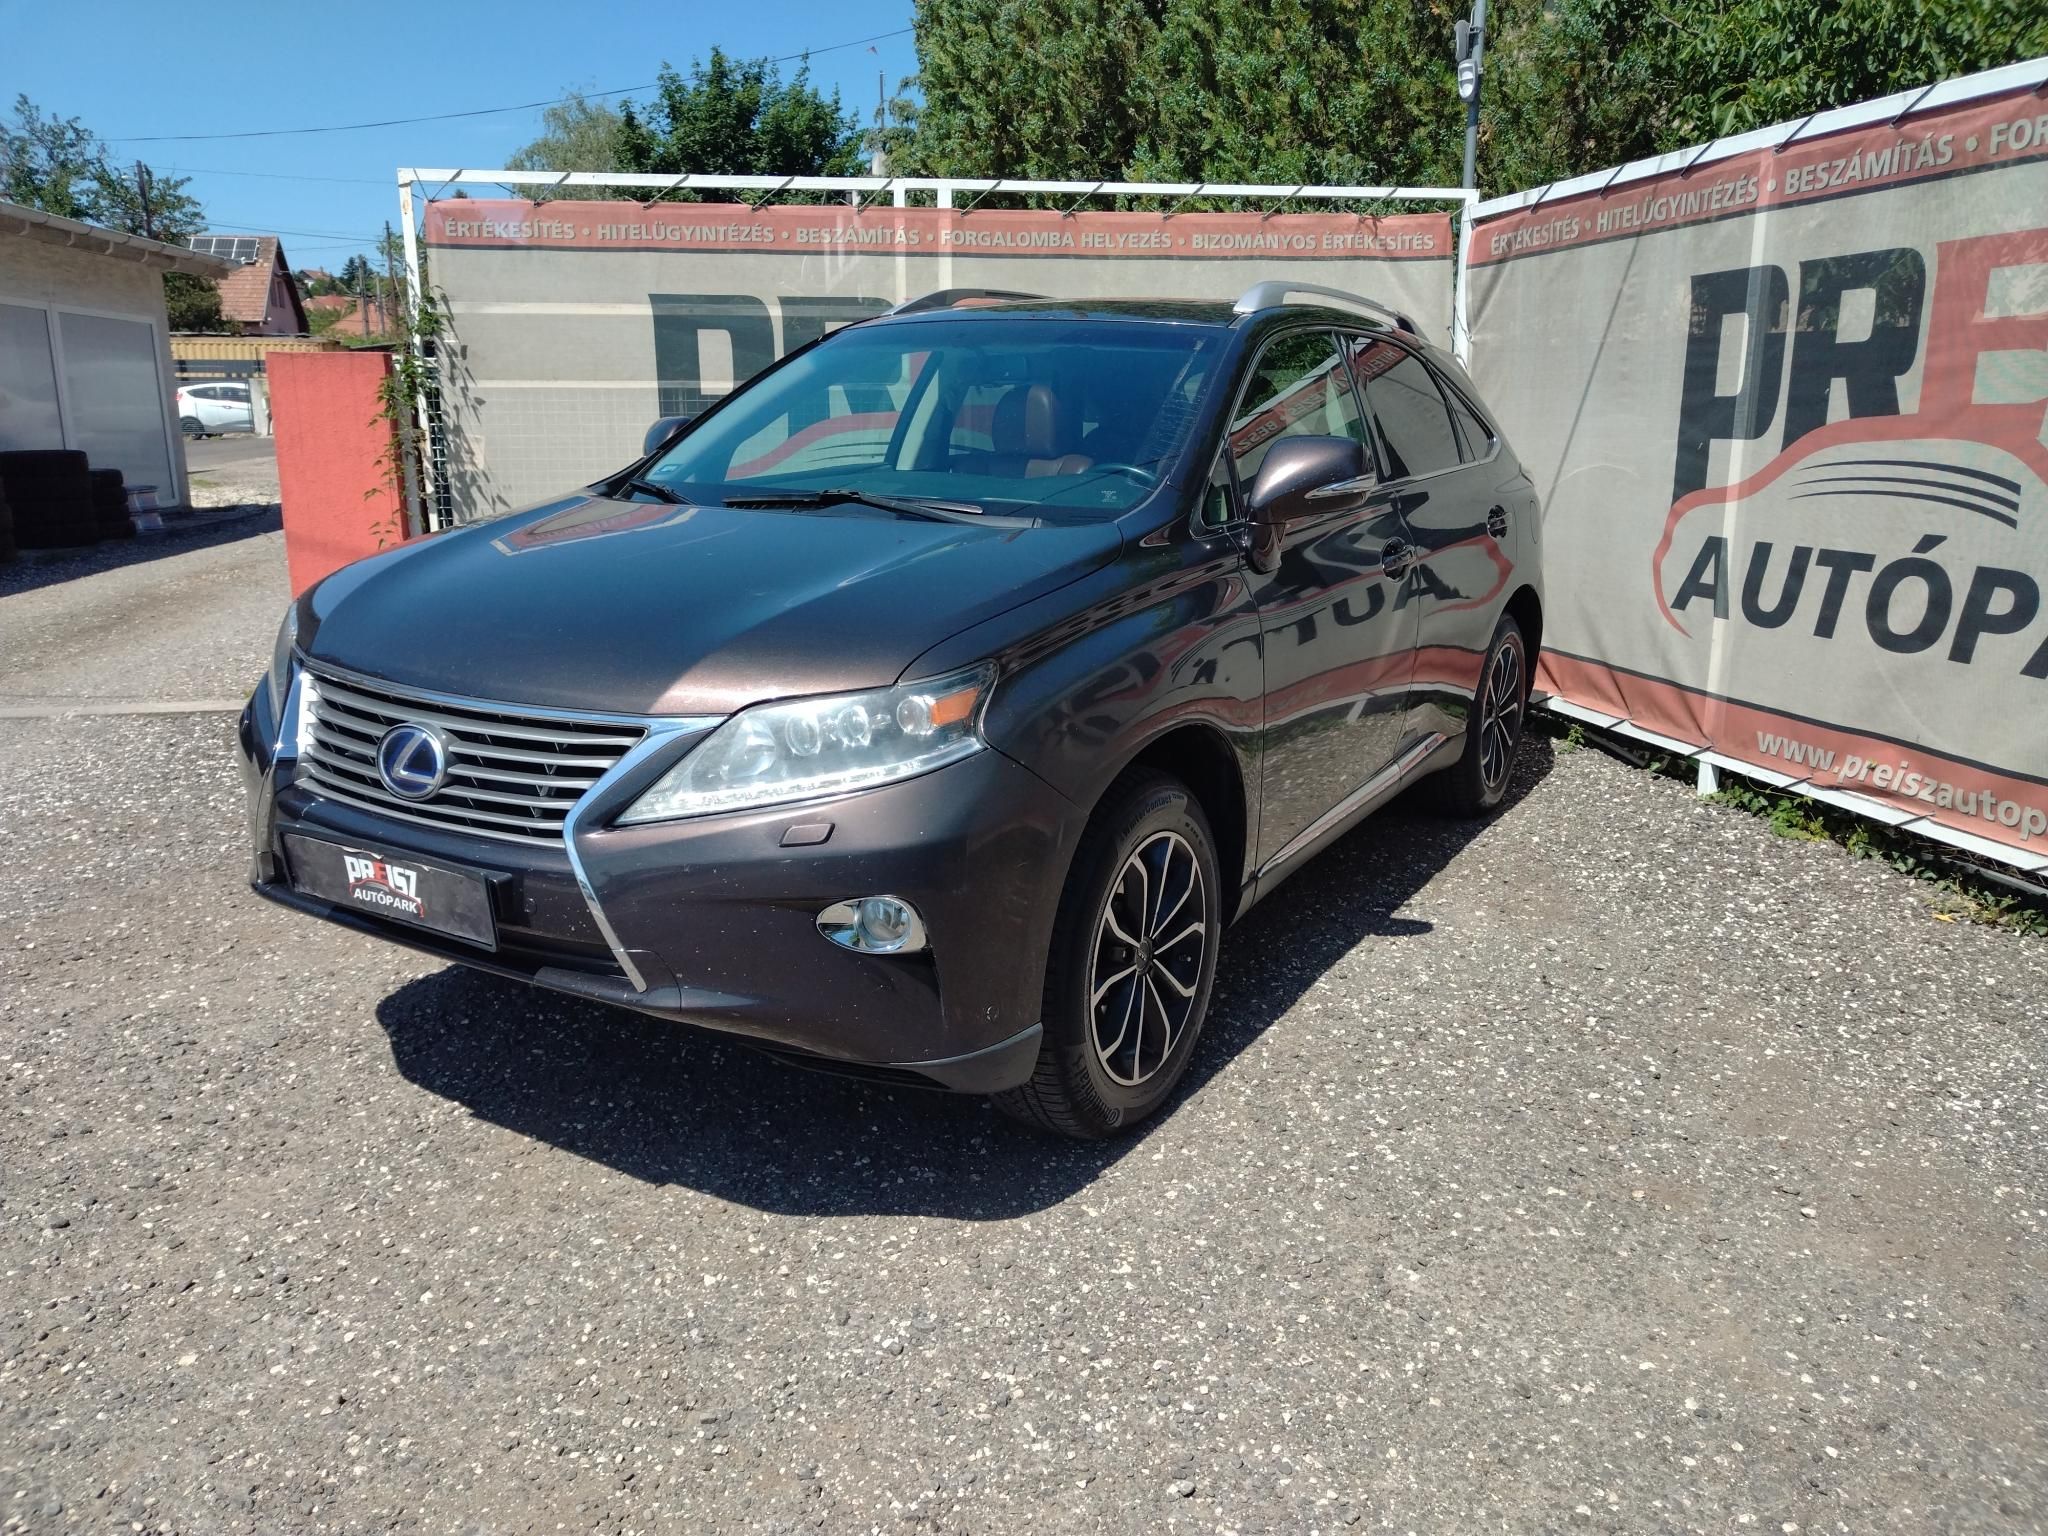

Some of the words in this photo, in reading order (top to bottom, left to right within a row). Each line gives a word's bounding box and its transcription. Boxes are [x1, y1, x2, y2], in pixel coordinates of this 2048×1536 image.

[1490, 214, 1580, 255] ÉRTÉKESÍTÉS
[1597, 173, 1759, 233] HITELÜGYINTÉZÉS
[1784, 132, 1955, 196] BESZÁMÍTÁS
[445, 217, 576, 240] ÉRTÉKESÍTÉS
[597, 221, 776, 244] HITELÜGYINTÉZÉS
[796, 225, 920, 246] BESZÁMÍTÁS
[941, 230, 1075, 249] FORGALOMBA
[1081, 228, 1172, 249] HELYEZÉS
[1192, 230, 1317, 250] BIZOMÁNYOS
[1322, 229, 1435, 252] ÉRTÉKESÍTÉS
[353, 888, 418, 914] AUTÓPARK
